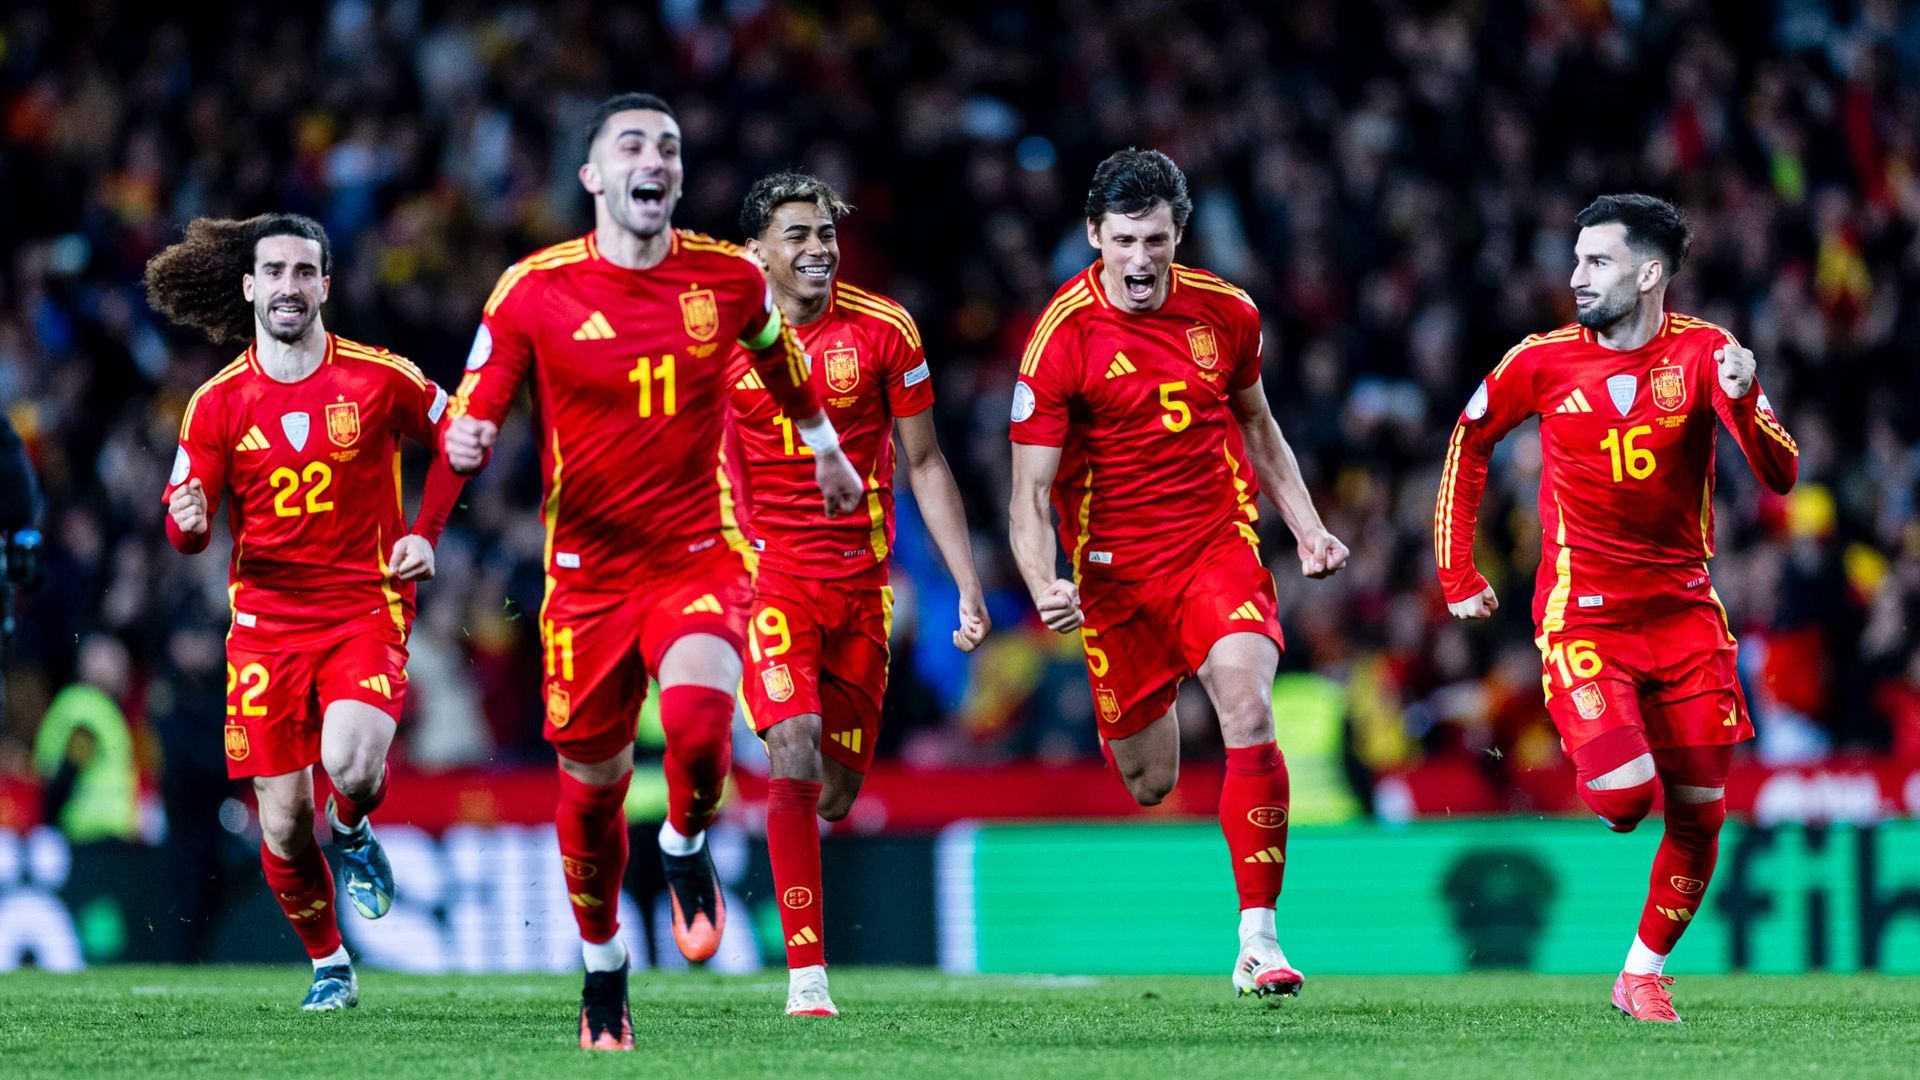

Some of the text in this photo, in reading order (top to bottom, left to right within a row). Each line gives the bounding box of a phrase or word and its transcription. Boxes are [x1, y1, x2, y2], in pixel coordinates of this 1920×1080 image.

[628, 354, 676, 418] 11
[1159, 380, 1192, 433] 5
[772, 408, 817, 456] 1
[1599, 425, 1656, 482] 16
[269, 461, 334, 518] 22
[544, 619, 574, 681] 11
[748, 606, 792, 663] 19
[1081, 626, 1109, 678] 5
[1548, 639, 1603, 689] 16
